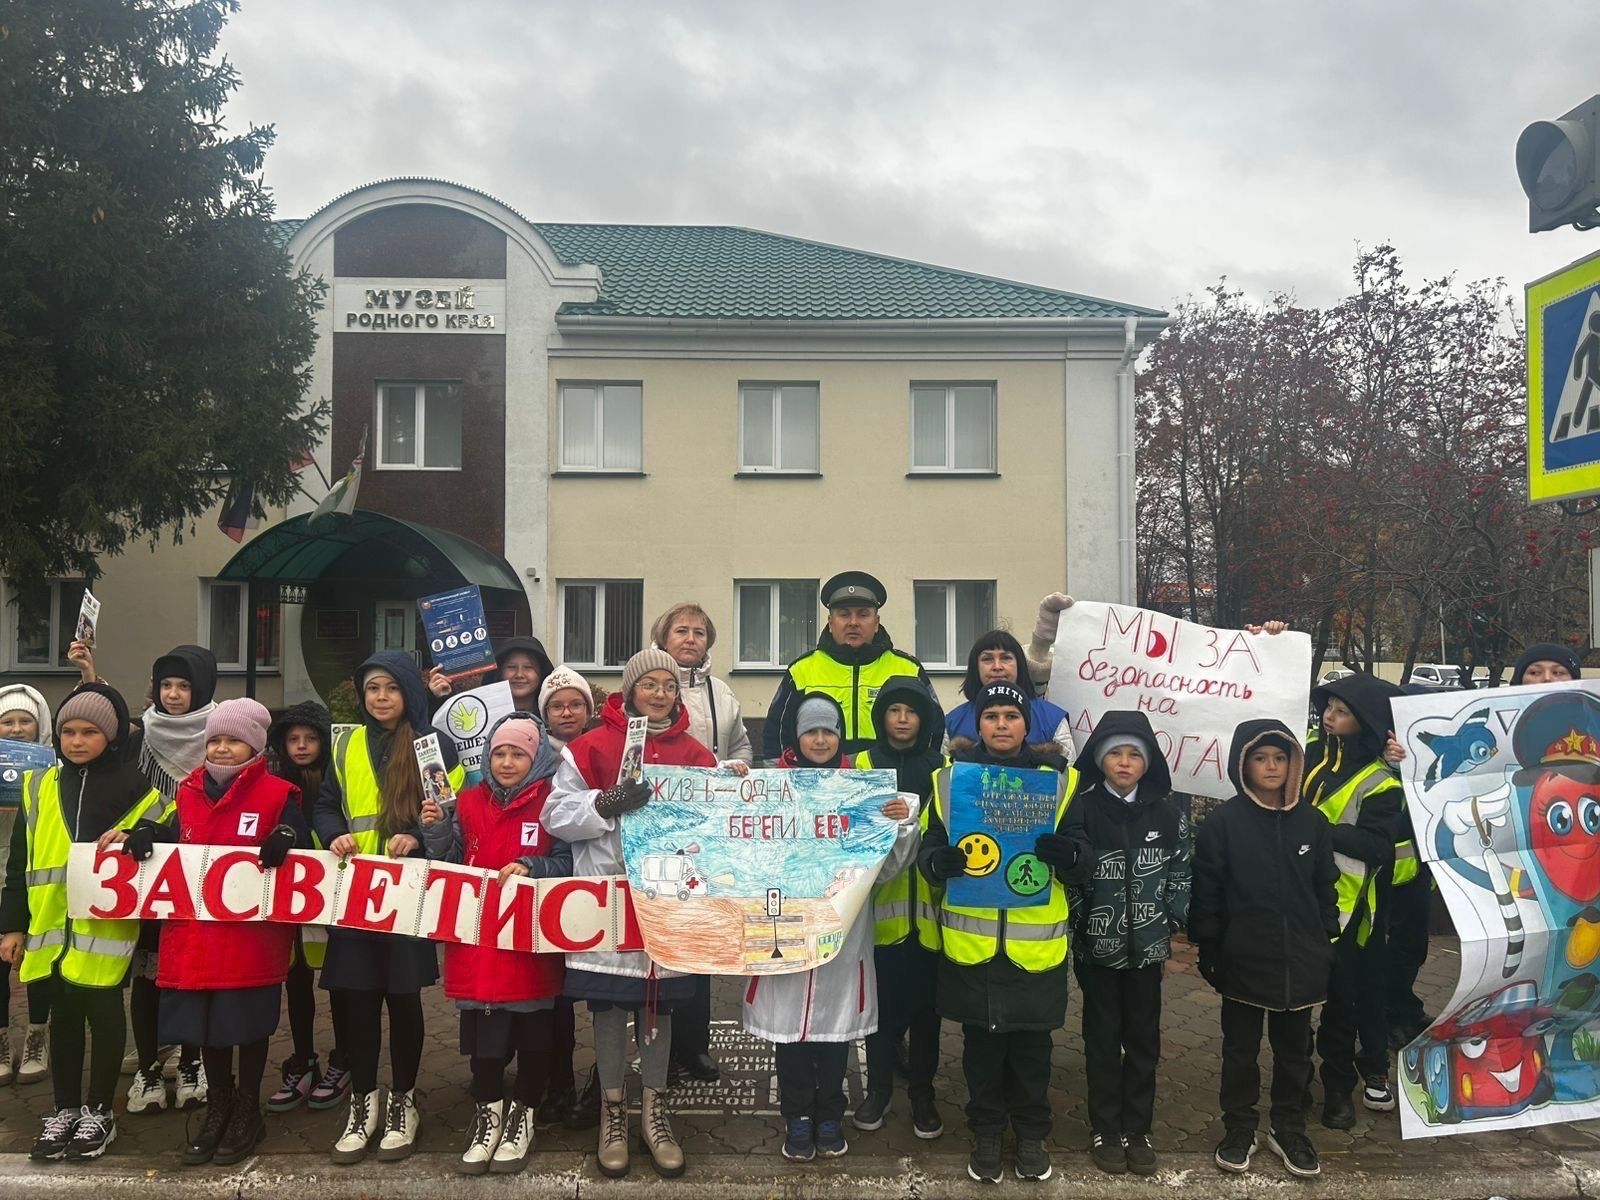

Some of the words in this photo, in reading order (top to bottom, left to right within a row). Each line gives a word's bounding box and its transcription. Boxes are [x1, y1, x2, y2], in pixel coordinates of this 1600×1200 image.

[366, 286, 475, 309] МУЗЕЙ
[347, 313, 439, 330] РОДНОГО
[446, 314, 495, 329] КРАЯ
[1103, 607, 1178, 663] МЫ
[1199, 630, 1262, 673] ЗА
[1079, 647, 1252, 699] безопасность
[987, 686, 1023, 704] WHITE
[1138, 695, 1178, 716] на
[648, 776, 715, 802] ЖИЗНЬ
[740, 779, 793, 802] ОДНА
[815, 810, 850, 839] ЕЁ!
[666, 1088, 756, 1097] РЕБЕНК
